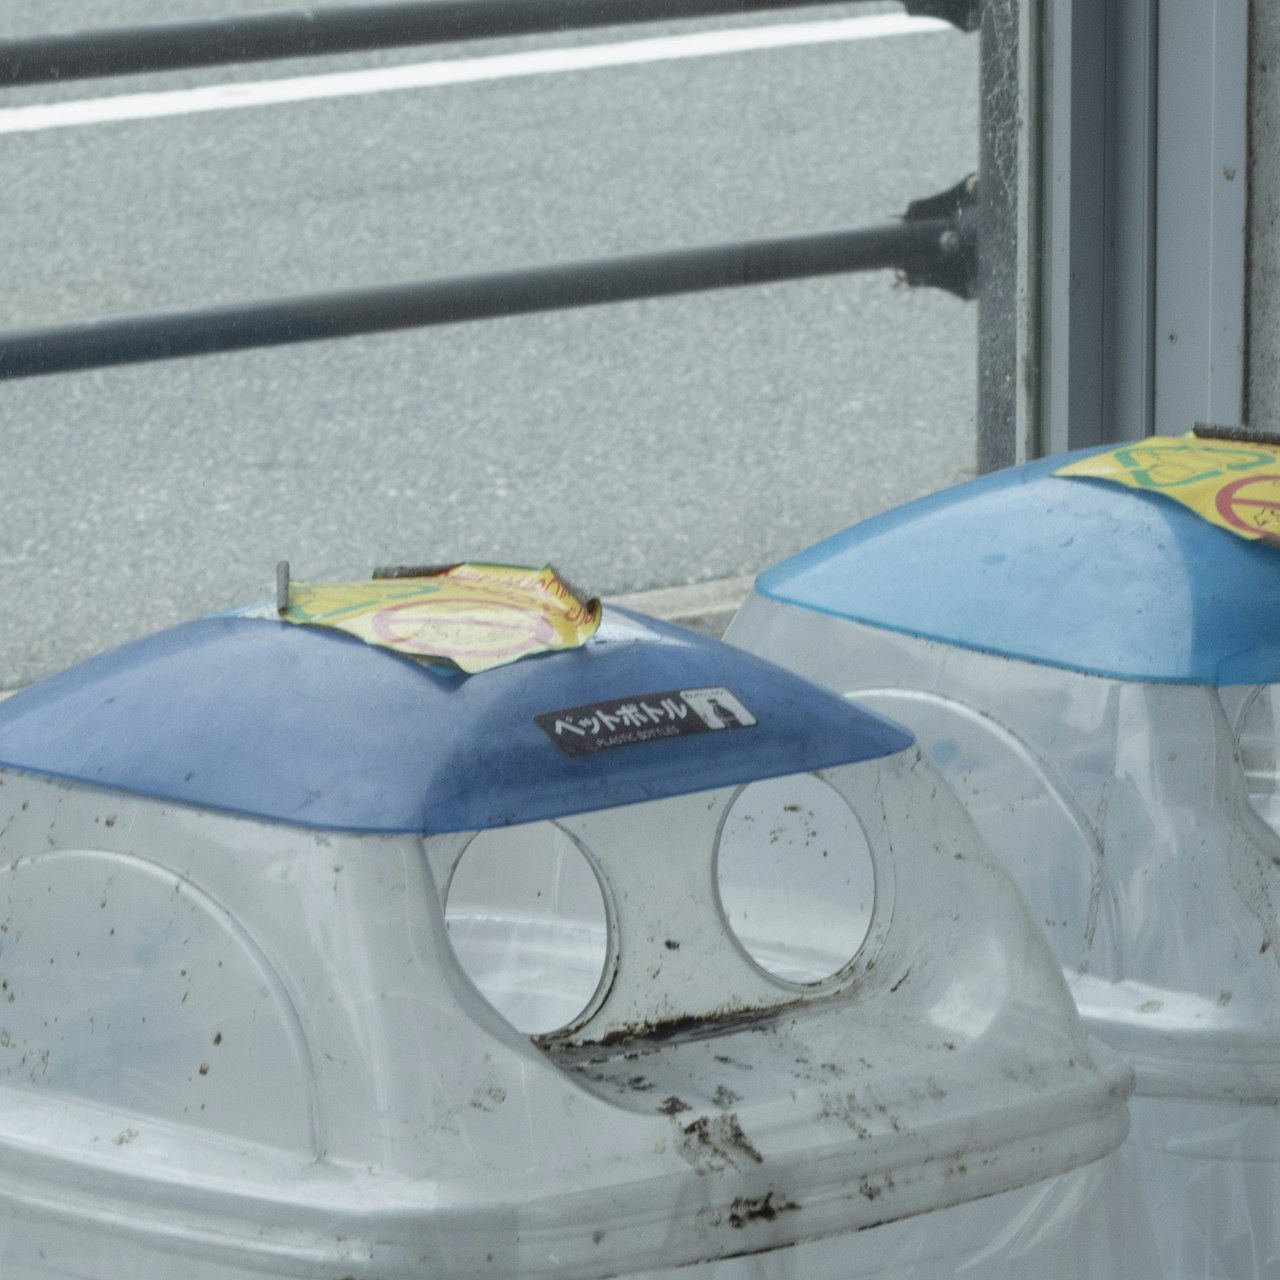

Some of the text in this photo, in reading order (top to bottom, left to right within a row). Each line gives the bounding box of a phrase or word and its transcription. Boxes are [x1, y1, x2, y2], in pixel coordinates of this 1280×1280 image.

[554, 698, 688, 737] ペットボトル
[595, 732, 638, 747] PLASTIC
